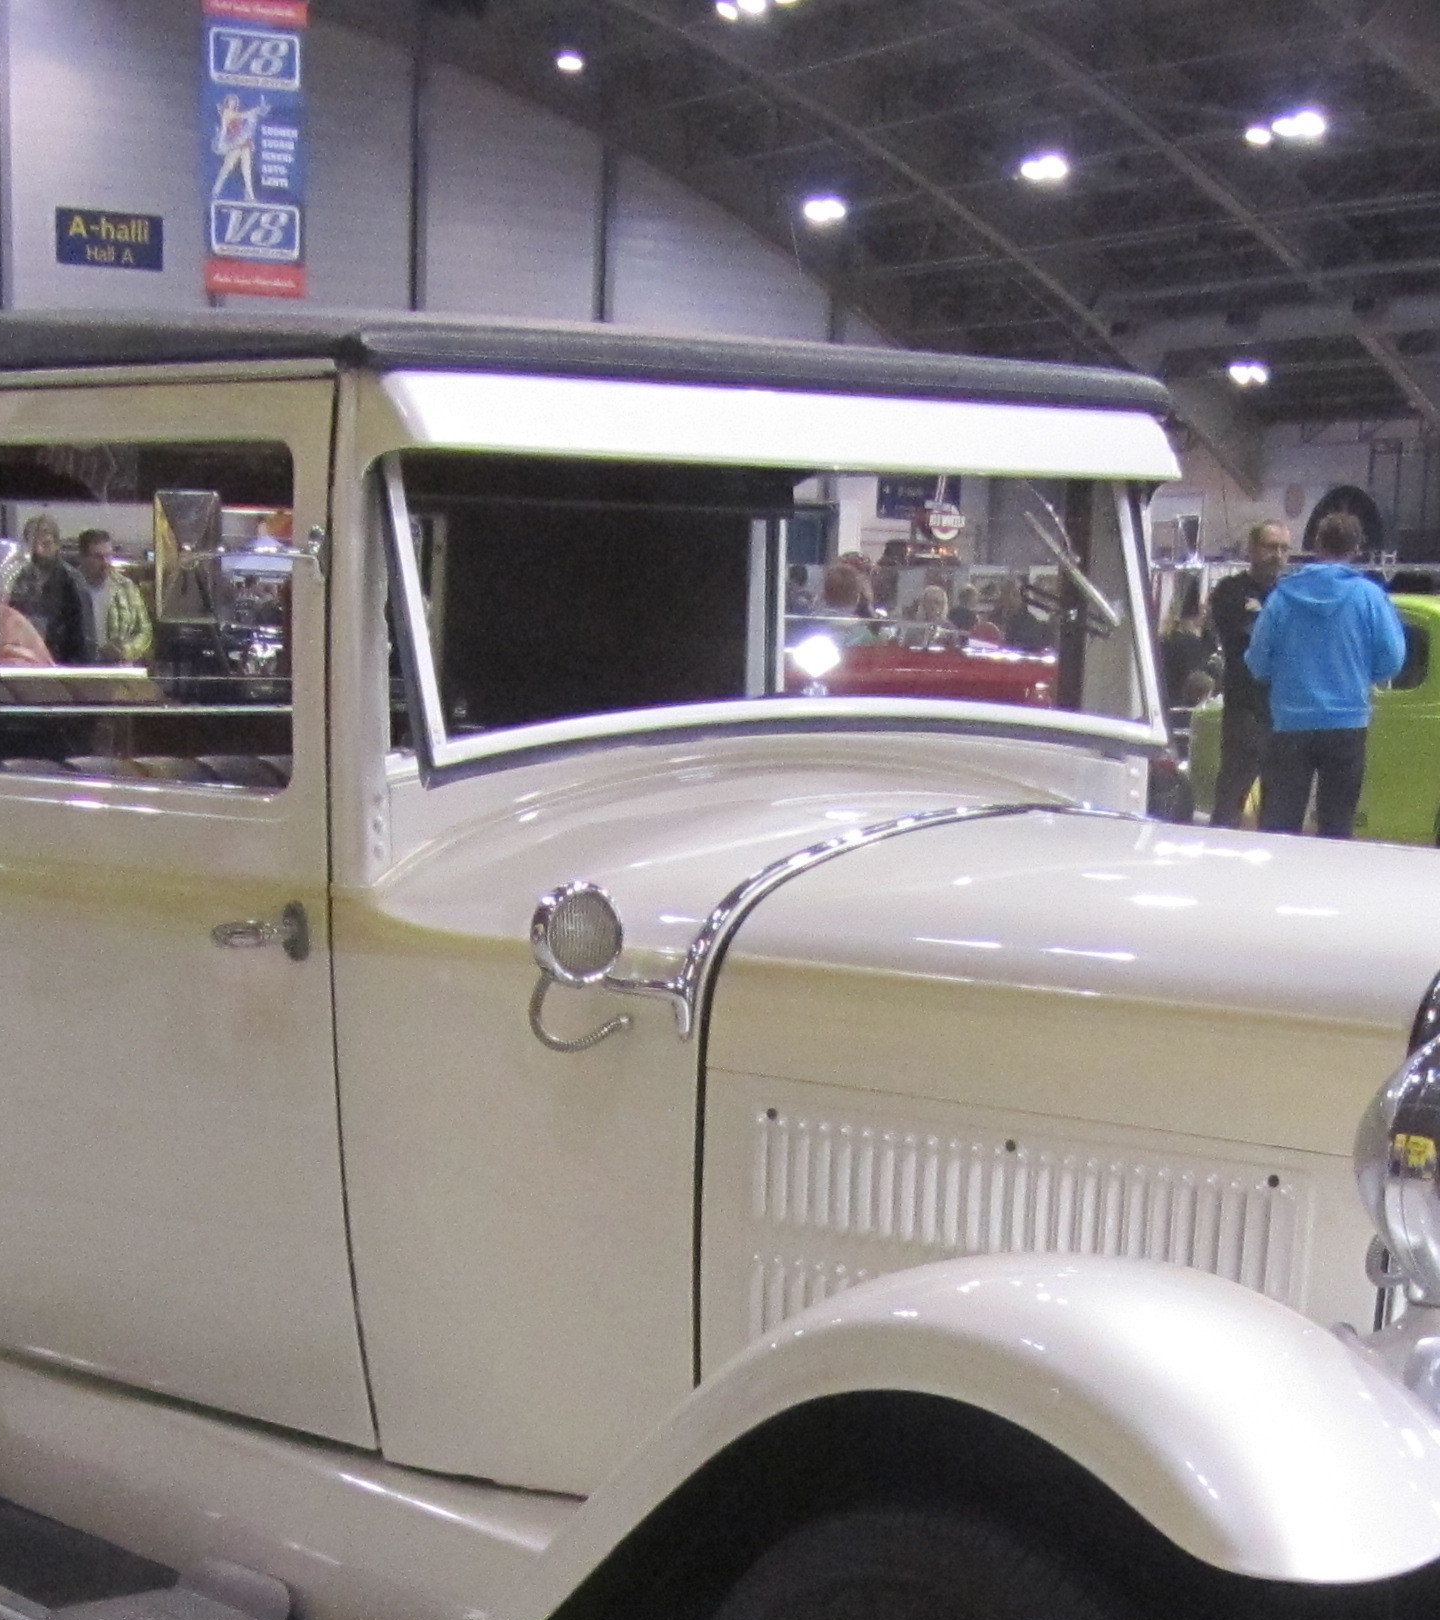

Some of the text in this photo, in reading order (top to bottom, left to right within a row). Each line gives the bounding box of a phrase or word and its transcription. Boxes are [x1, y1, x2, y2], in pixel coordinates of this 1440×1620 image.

[219, 37, 290, 76] V8
[69, 215, 150, 243] A-halli
[220, 209, 289, 247] V8
[86, 244, 134, 264] Hall A
